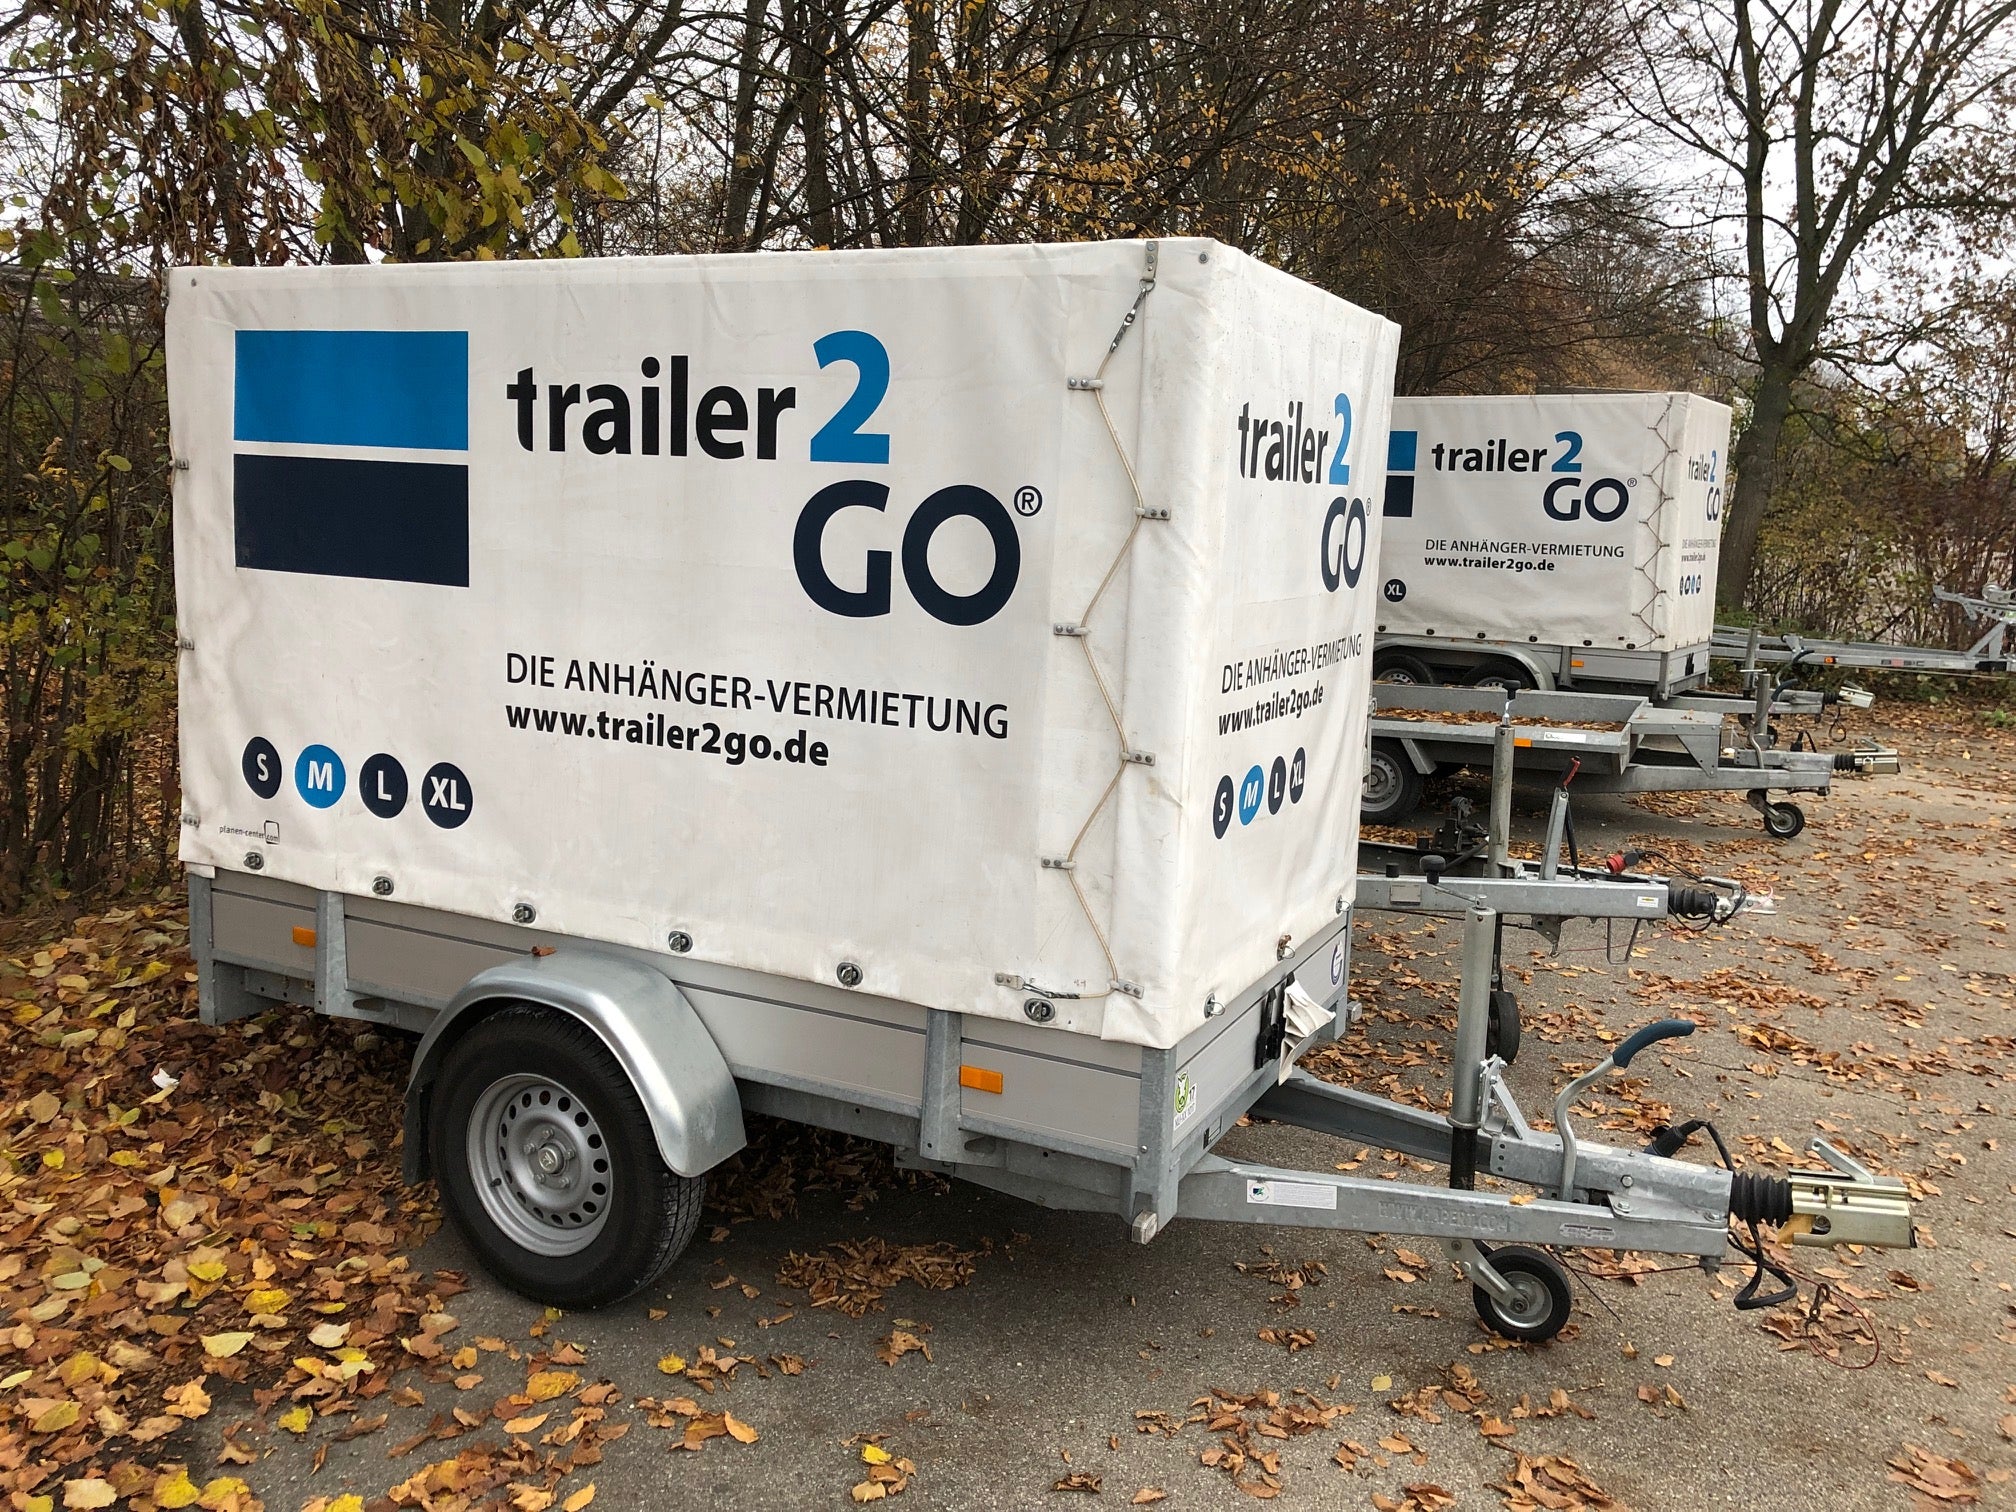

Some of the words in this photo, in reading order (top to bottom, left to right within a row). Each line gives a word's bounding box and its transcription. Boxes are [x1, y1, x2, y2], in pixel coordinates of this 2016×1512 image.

[1424, 556, 1555, 572] www.trailer2go.de
[1425, 539, 1447, 551] DIE
[1449, 539, 1625, 558] ANHÄNGER-VERMIETUNG
[1387, 583, 1403, 596] XL
[1221, 661, 1243, 694] DIE
[1245, 633, 1362, 688] ANHÄNGER-VERMIETUNG
[506, 653, 554, 687] DIE
[564, 660, 1009, 739] ANHÄNGER-VERMIETUNG
[1218, 679, 1324, 736] www.trailer2go.de
[506, 705, 829, 766] www.trailer2go.de
[256, 753, 269, 782] S
[307, 760, 333, 792] M
[377, 770, 392, 801] L
[429, 776, 466, 811] XL
[1218, 791, 1227, 822] S
[1243, 780, 1259, 810] M
[1273, 772, 1280, 799] L
[1291, 760, 1303, 789] XL
